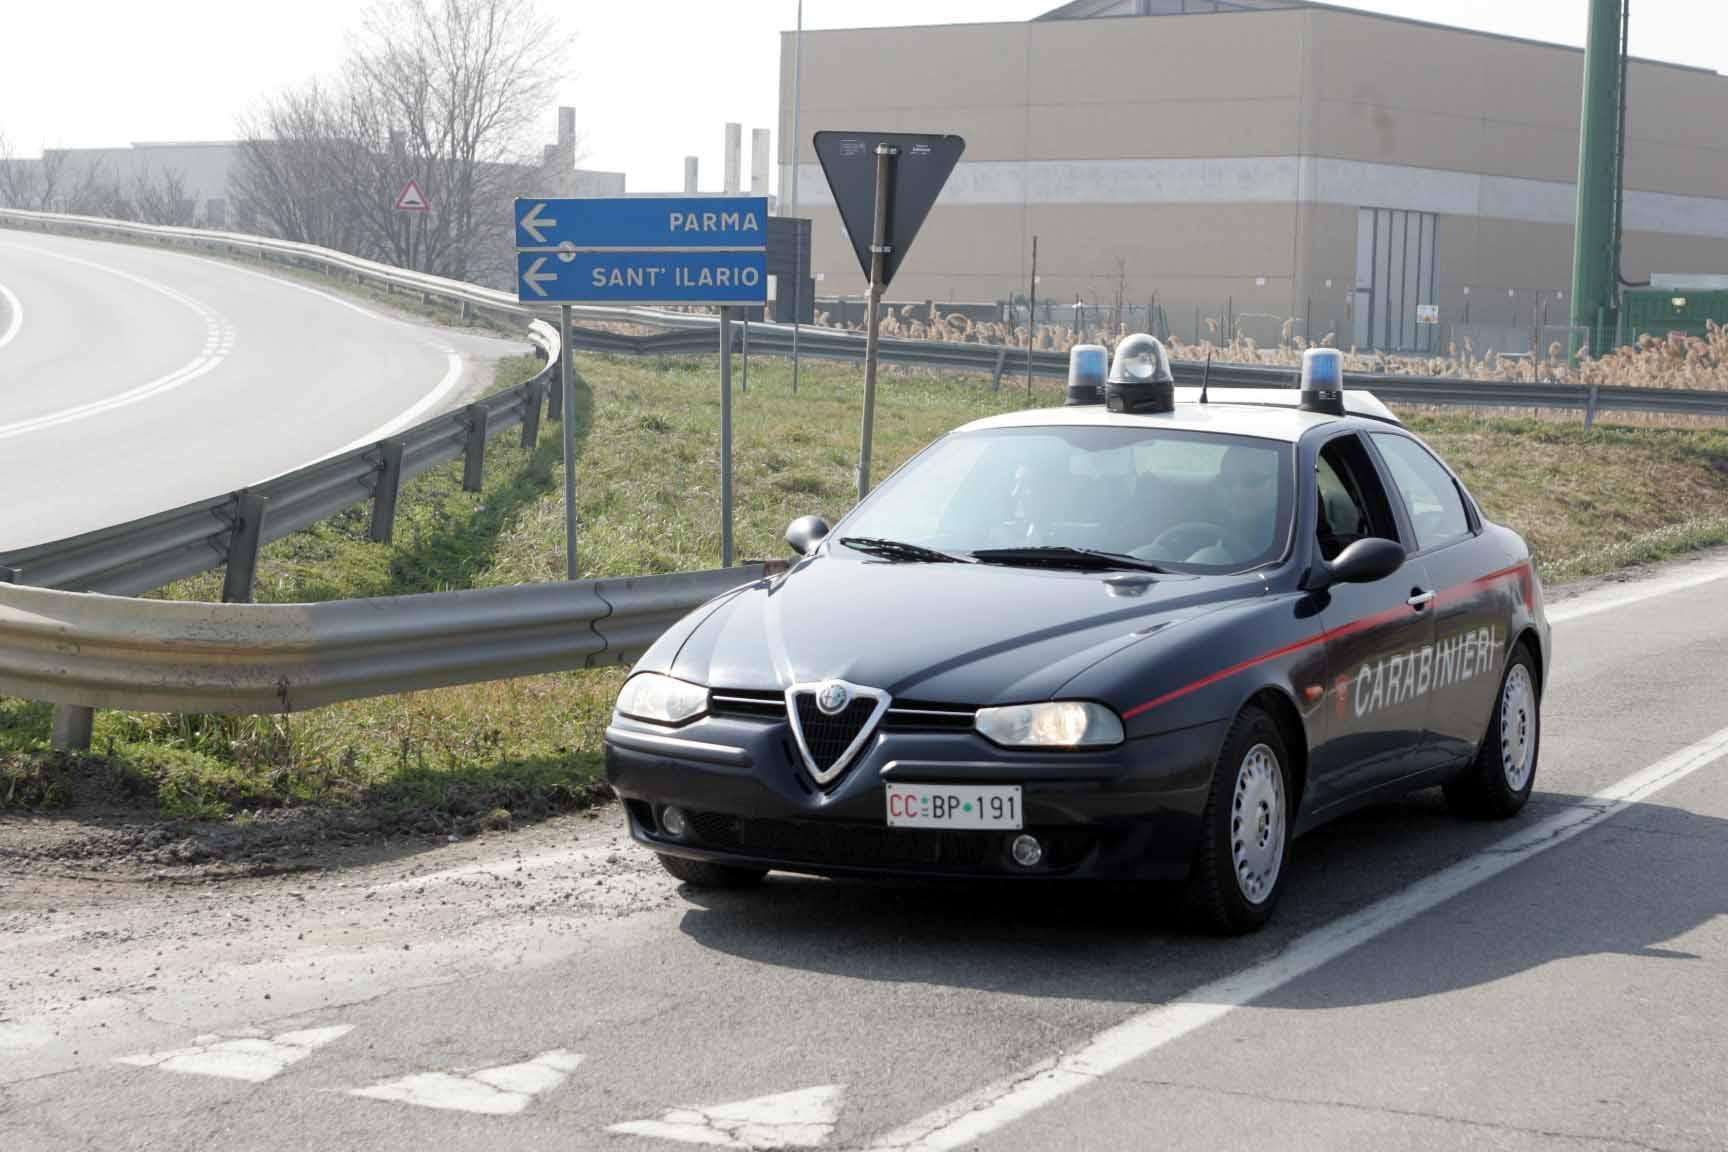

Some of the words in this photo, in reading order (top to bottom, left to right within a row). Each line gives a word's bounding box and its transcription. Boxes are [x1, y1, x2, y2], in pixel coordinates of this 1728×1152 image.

[670, 212, 759, 231] PARMA
[592, 267, 667, 287] SANT'
[675, 267, 759, 287] ILARIO
[1354, 625, 1496, 717] CARABINIERI
[932, 795, 960, 819] BP
[977, 796, 1015, 820] 191
